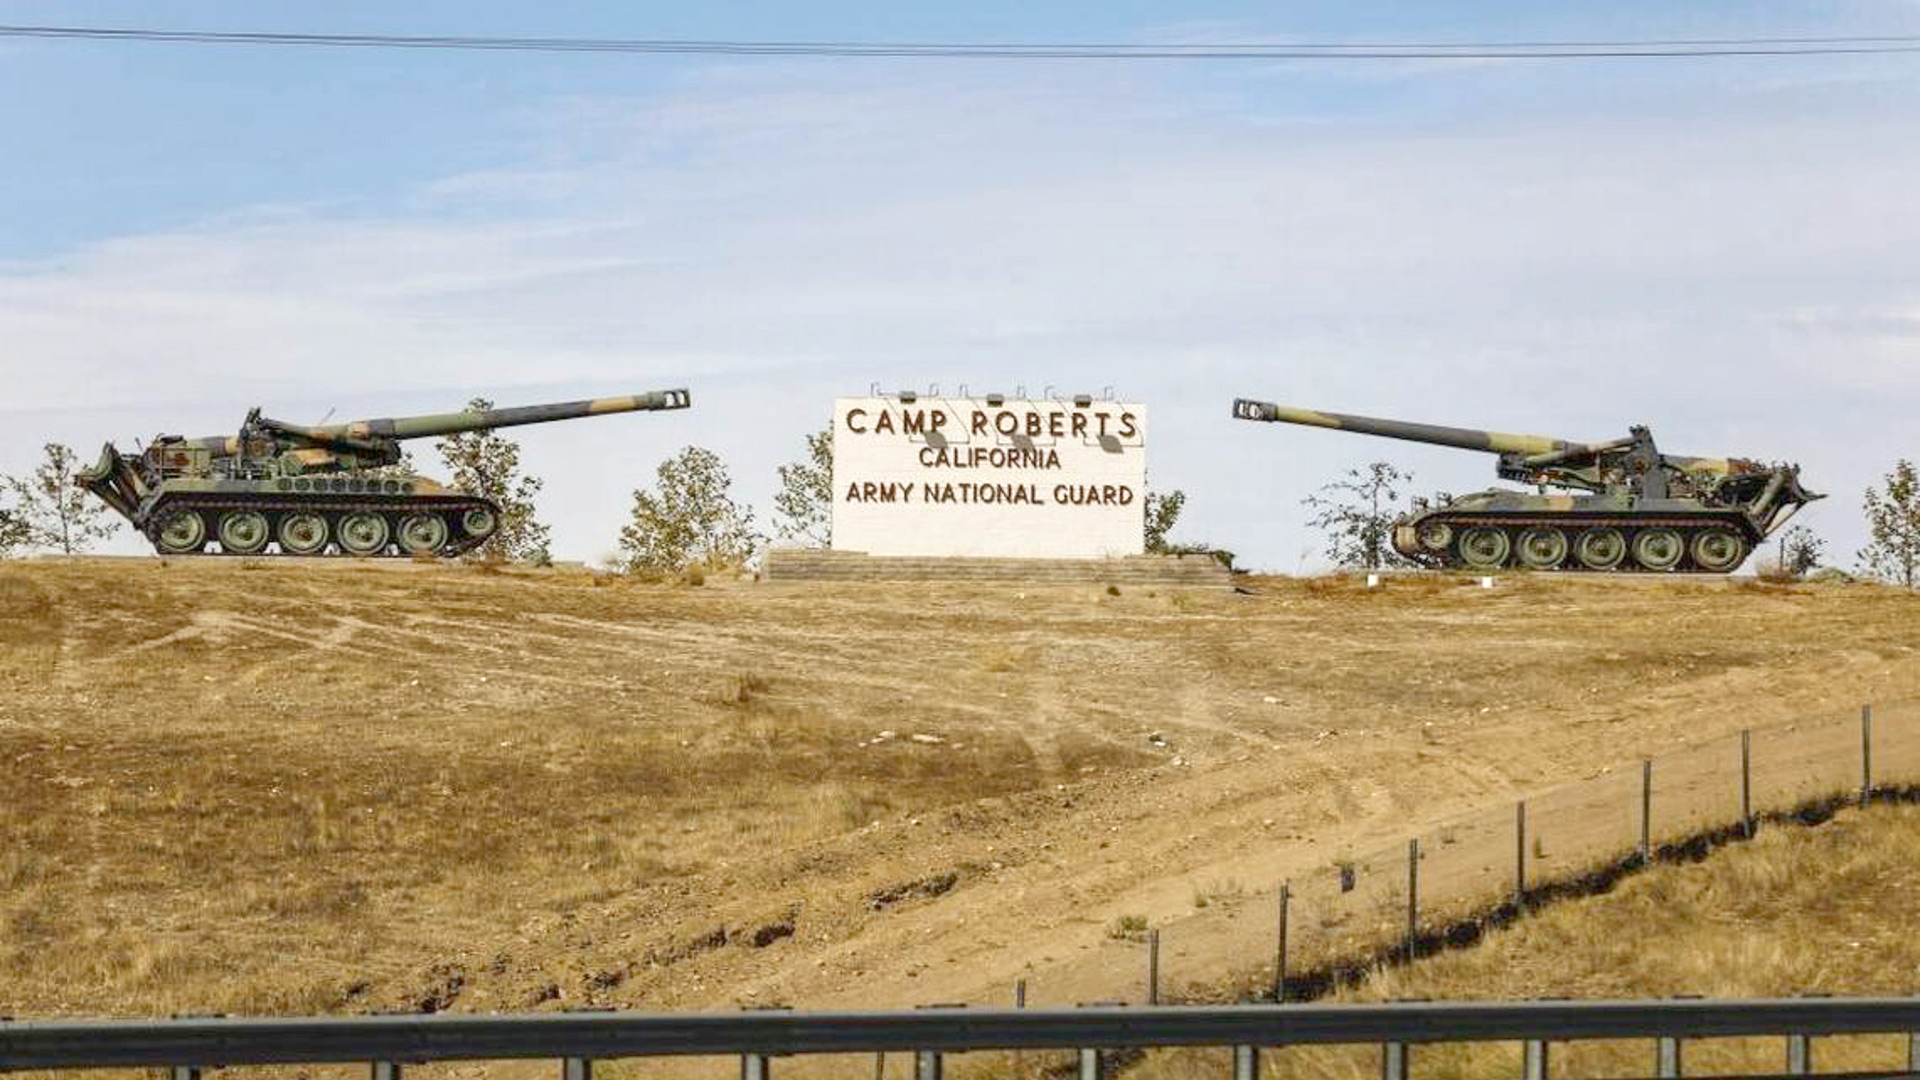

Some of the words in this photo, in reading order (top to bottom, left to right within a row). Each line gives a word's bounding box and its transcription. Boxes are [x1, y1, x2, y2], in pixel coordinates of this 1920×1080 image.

[846, 408, 946, 434] CAMP
[971, 411, 1136, 437] ROBERTS
[919, 447, 1061, 469] CALIFORNIA
[846, 482, 914, 503] ARMY
[924, 483, 1044, 504] NATIONAL
[1053, 485, 1134, 505] GUARD
